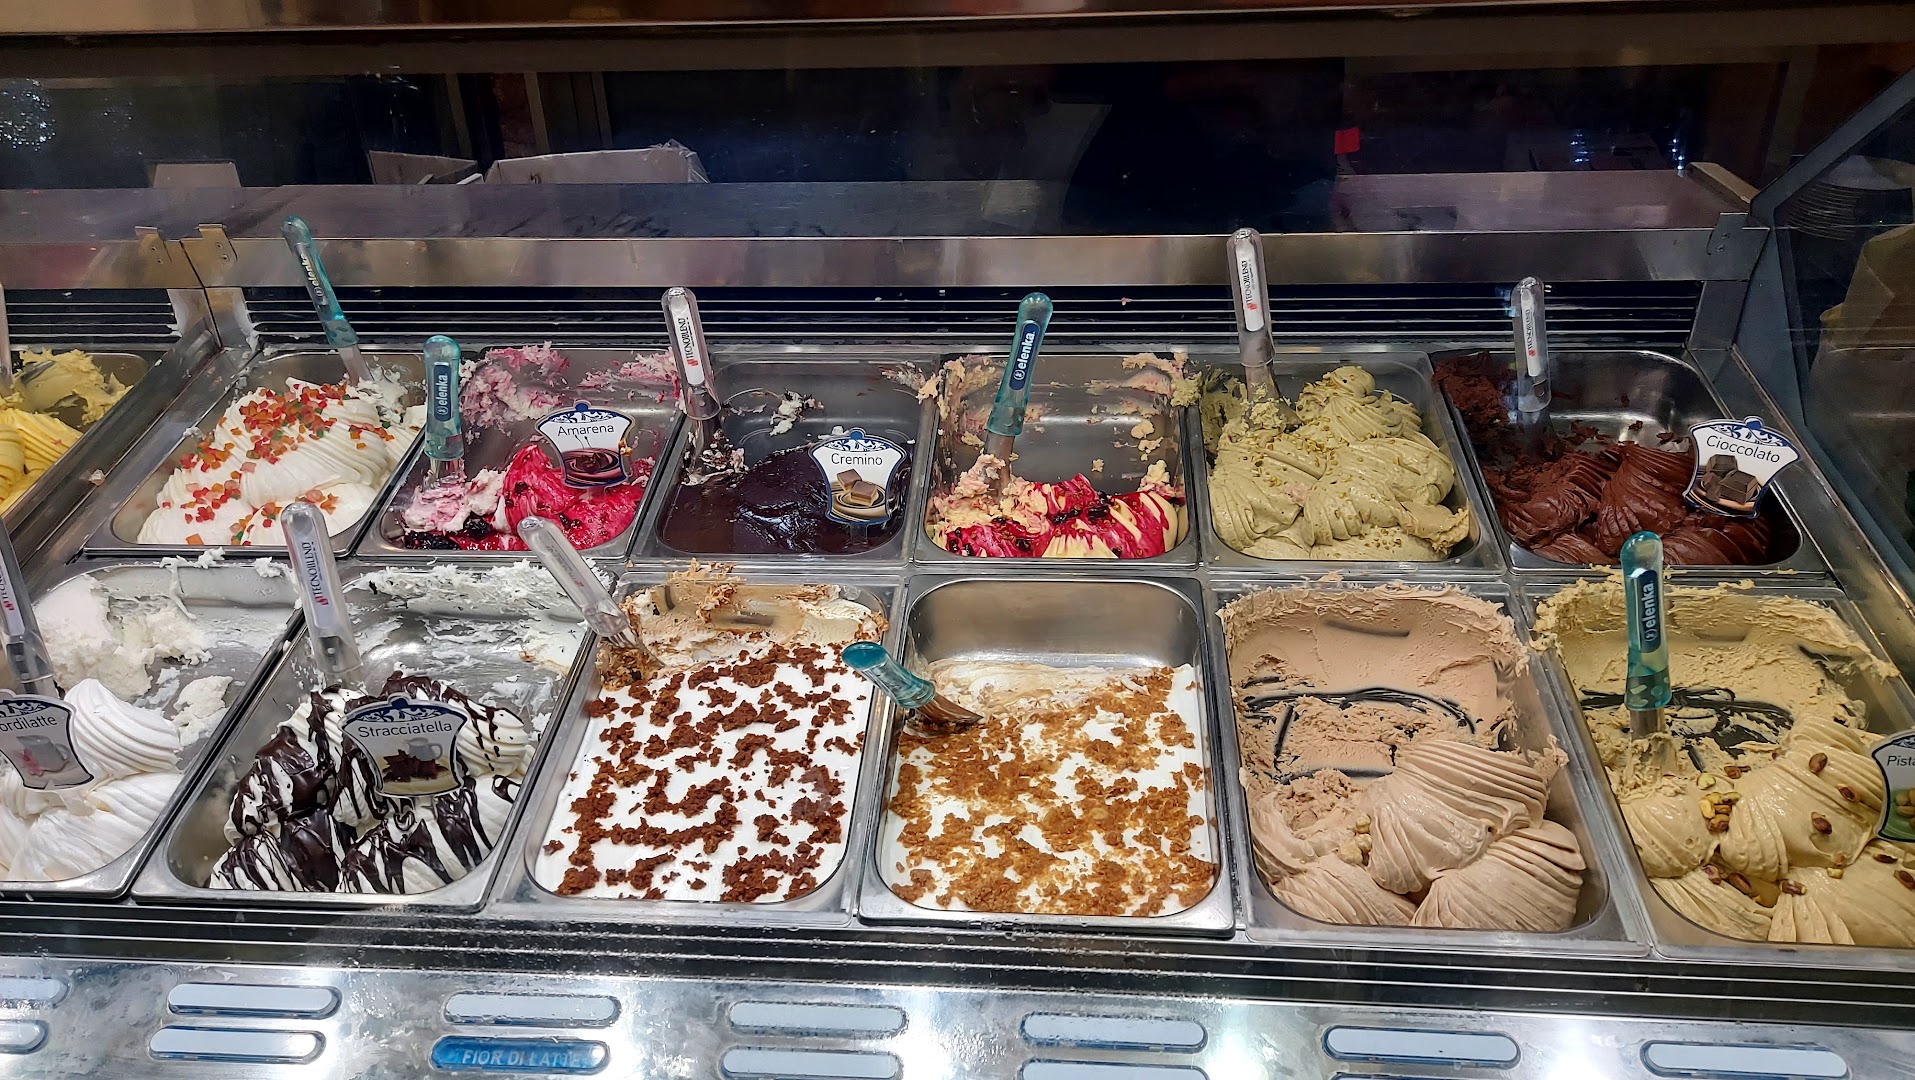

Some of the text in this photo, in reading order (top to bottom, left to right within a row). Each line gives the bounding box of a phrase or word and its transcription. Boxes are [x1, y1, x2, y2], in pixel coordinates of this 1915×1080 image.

[678, 317, 694, 359] TECNOBLEND
[1017, 331, 1036, 370] elenka
[436, 374, 448, 406] elenka
[557, 424, 615, 437] Amarena
[831, 453, 883, 466] Cremino
[1706, 435, 1780, 463] Cioccolato
[302, 541, 321, 599] TECNOBLEND
[1641, 582, 1656, 628] elenka
[0, 715, 58, 732] ordilatte
[358, 720, 453, 738] Stracciatella
[462, 1049, 503, 1066] FIOR
